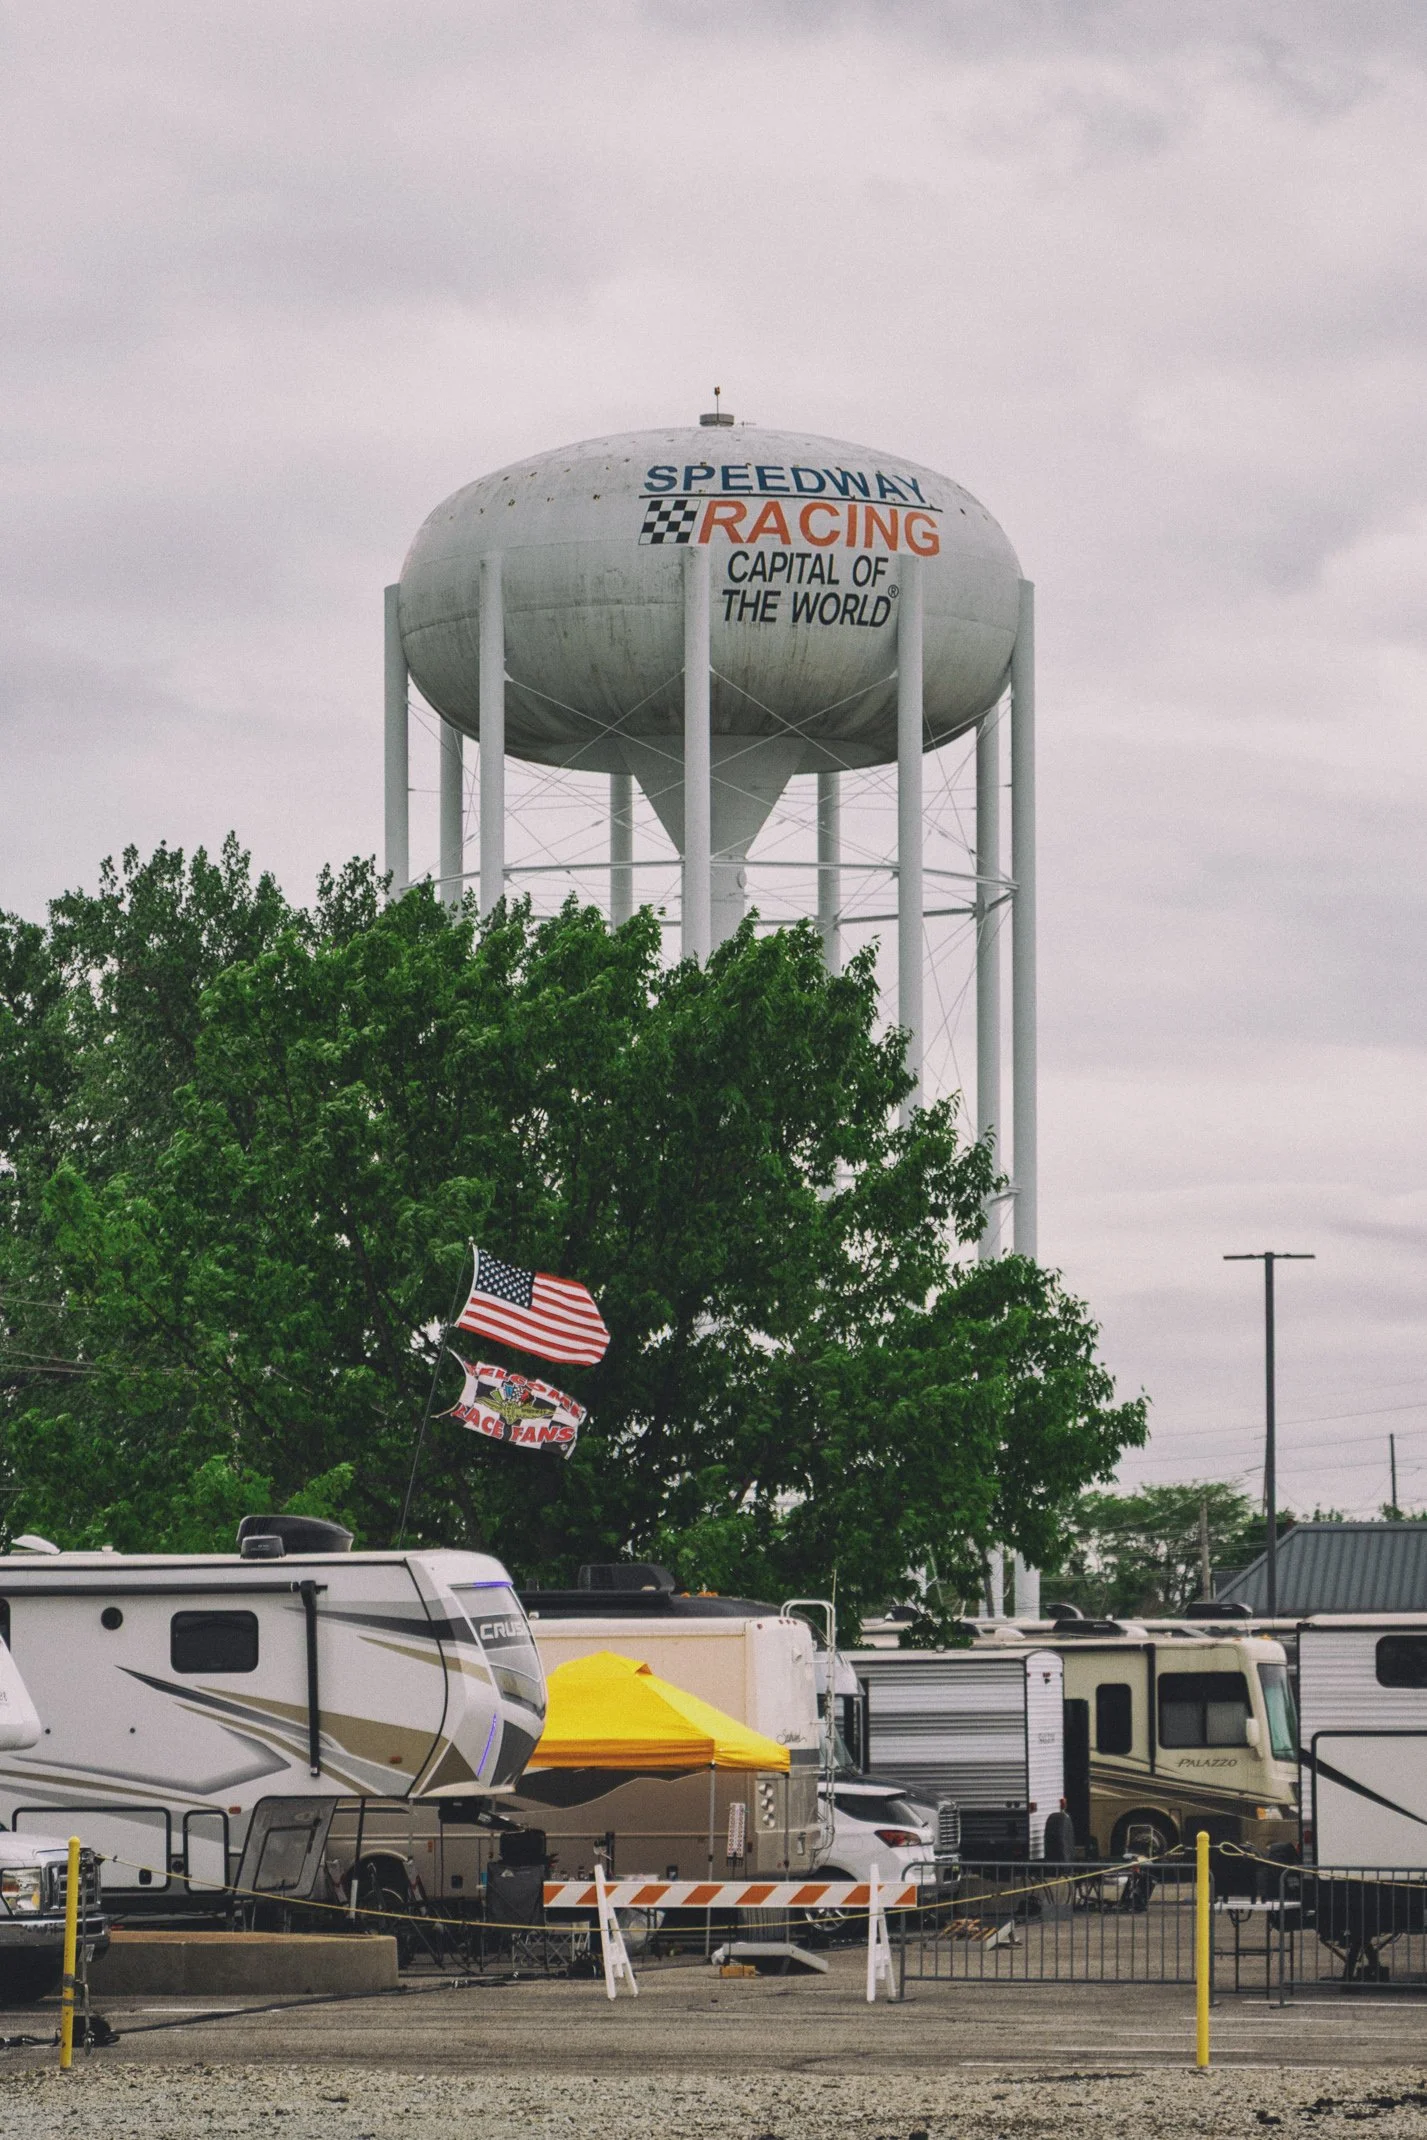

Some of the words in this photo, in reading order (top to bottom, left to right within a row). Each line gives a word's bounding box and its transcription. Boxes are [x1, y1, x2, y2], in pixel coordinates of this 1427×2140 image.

[644, 464, 927, 503] SPEEDWAY
[698, 500, 940, 557] RACING
[728, 550, 839, 585] CAPITAL
[853, 555, 889, 587] OF
[722, 589, 781, 623] THE
[791, 589, 891, 628] WORLD
[510, 1425, 576, 1444] FANS
[1176, 1758, 1238, 1768] PALAZZO
